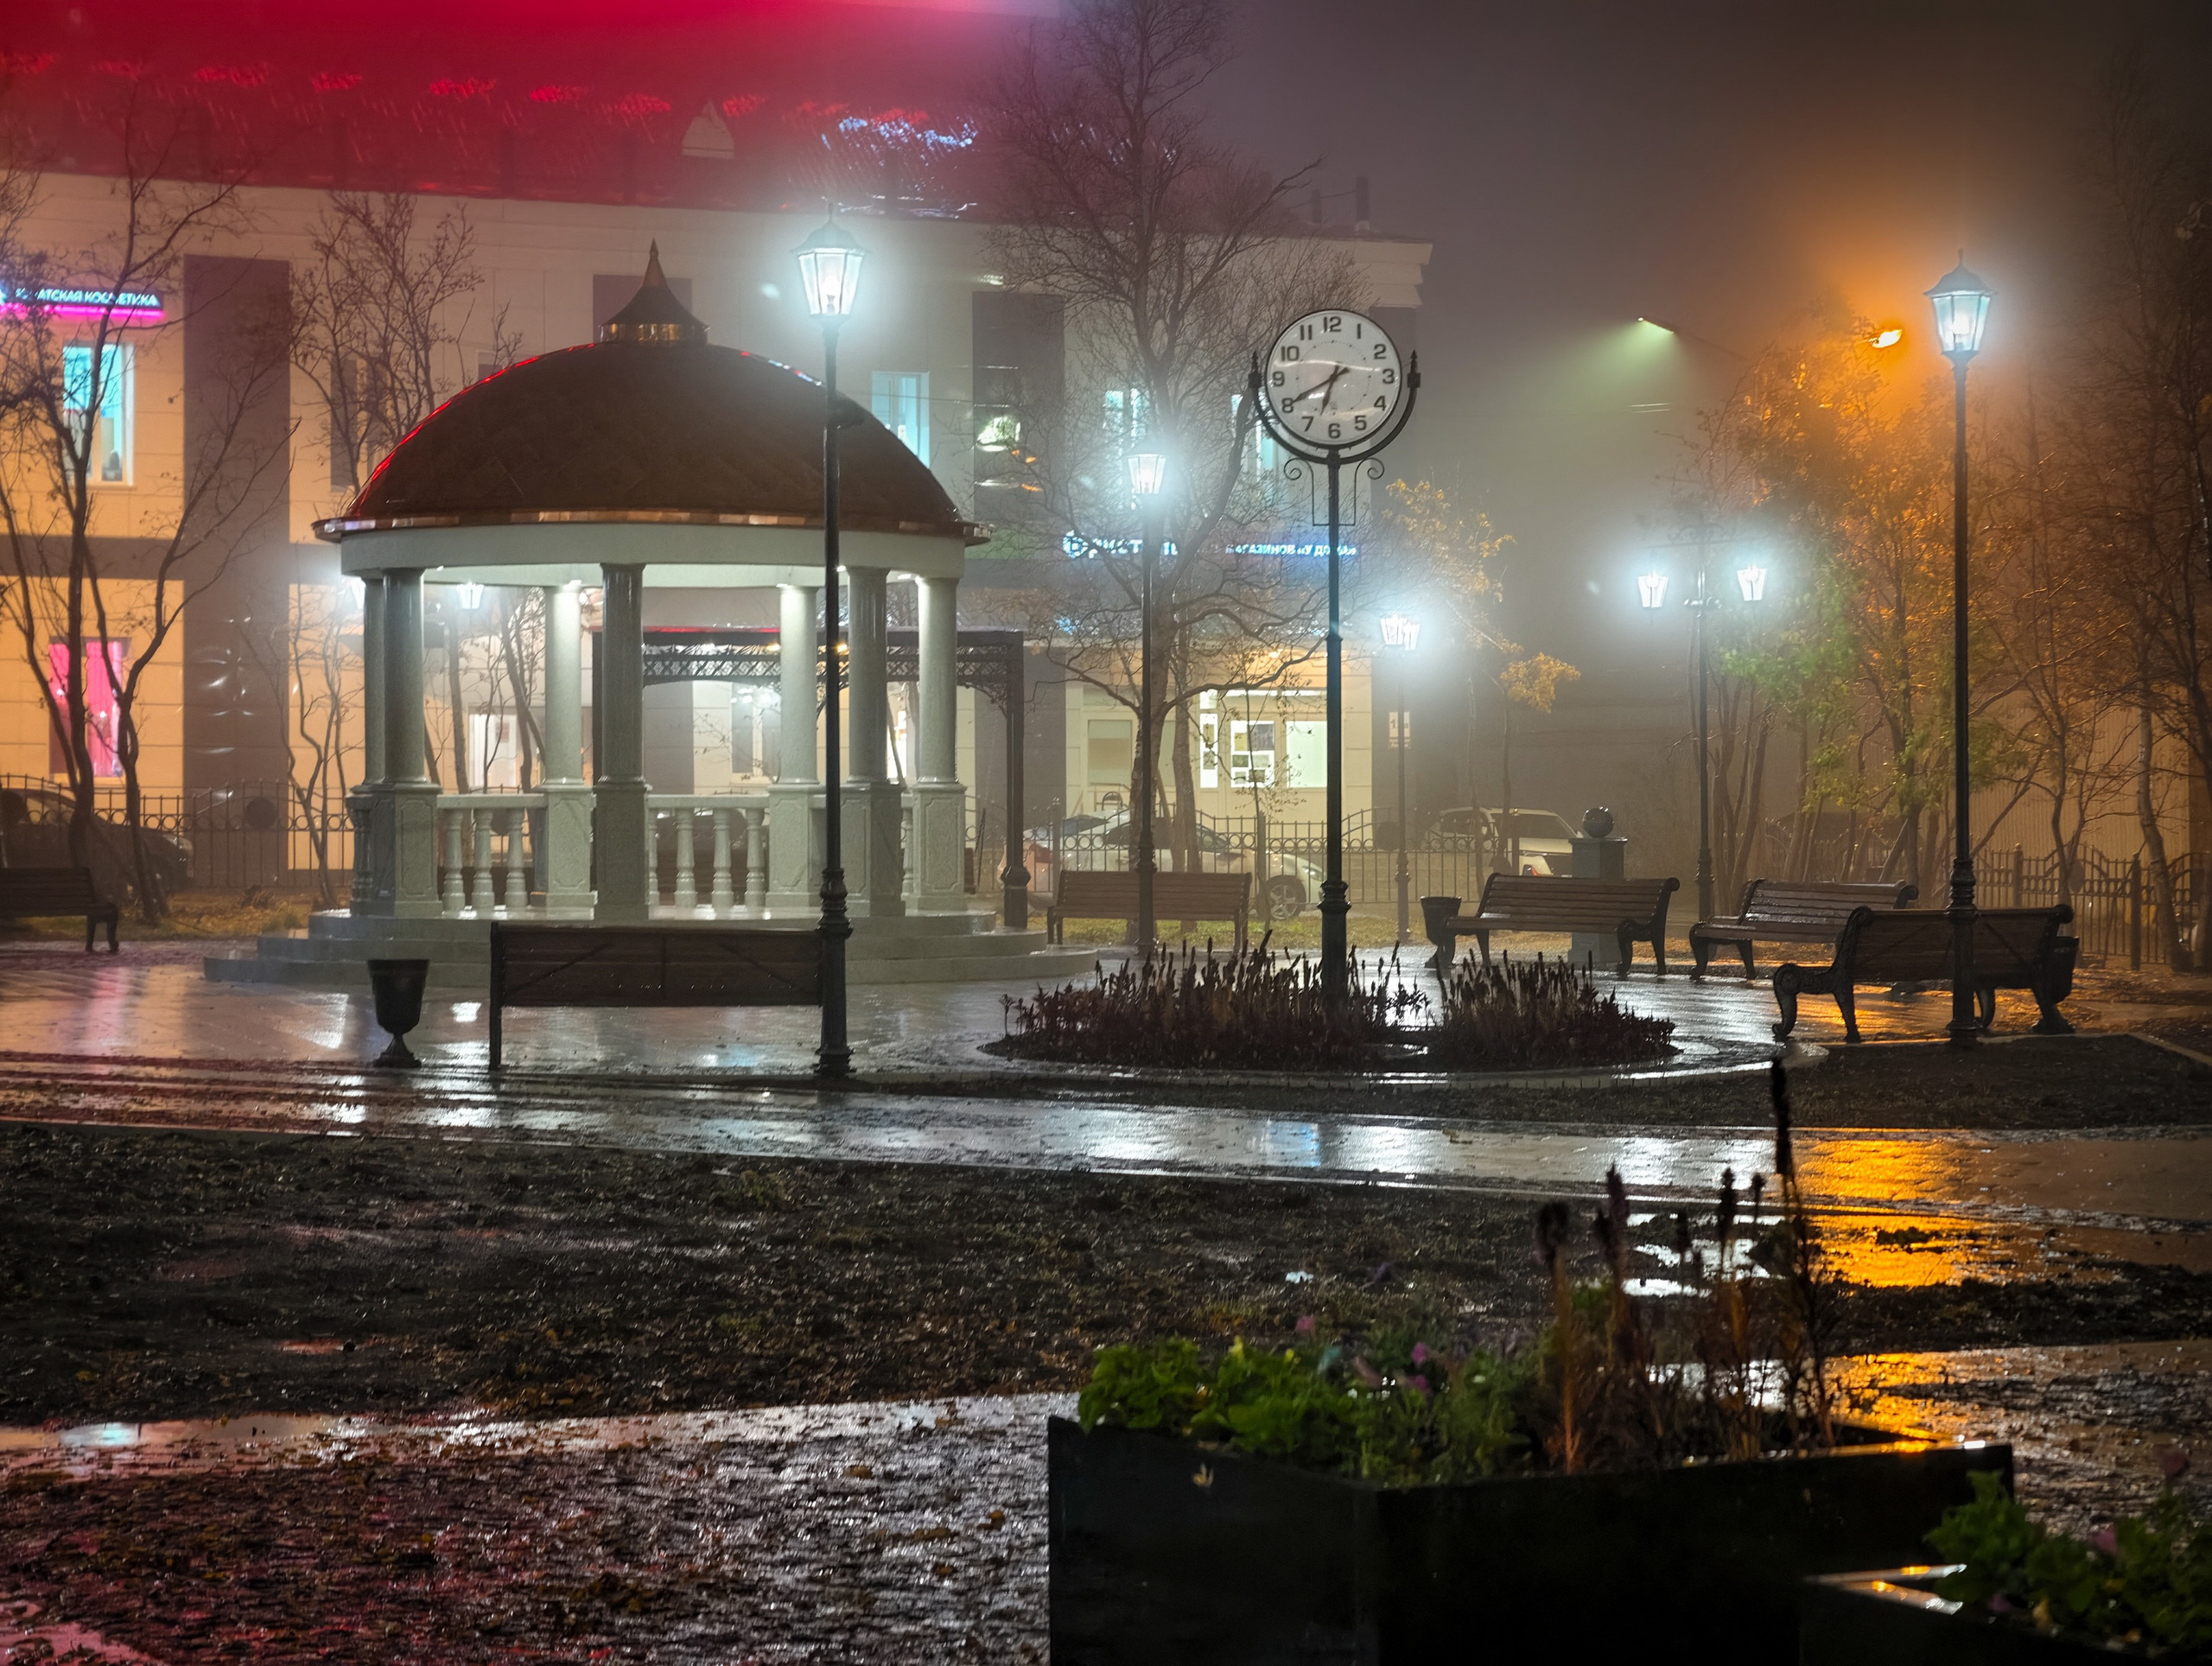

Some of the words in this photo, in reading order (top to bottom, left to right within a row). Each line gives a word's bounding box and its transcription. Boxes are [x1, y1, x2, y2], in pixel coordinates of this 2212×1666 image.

[1300, 324, 1313, 340] 11
[1324, 316, 1342, 333] 12
[1357, 323, 1362, 340] 1
[1281, 346, 1300, 362] 10
[1374, 344, 1387, 360] 2
[1273, 371, 1285, 387] 9
[1382, 369, 1395, 385] 3
[1281, 397, 1294, 414] 8
[1374, 396, 1387, 411] 4
[1301, 416, 1314, 432] 7
[1328, 423, 1341, 439] 6
[1355, 415, 1367, 431] 5
